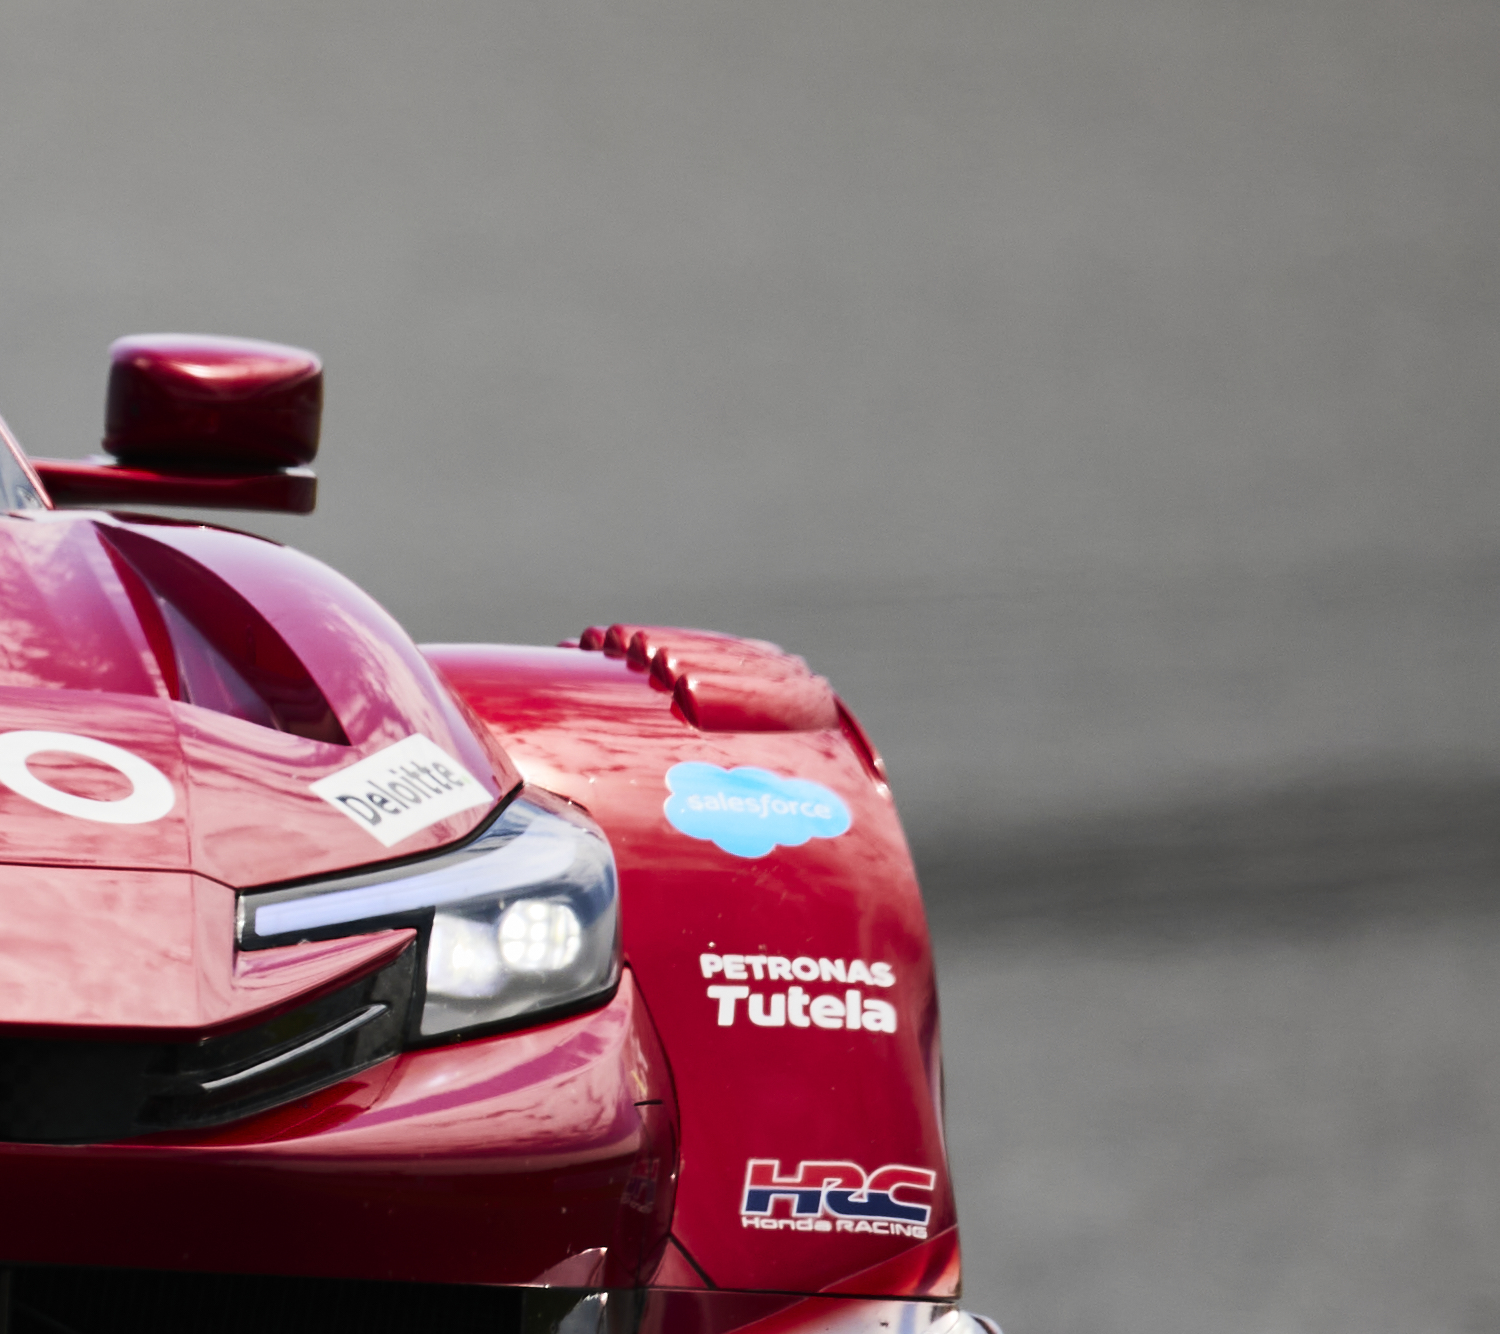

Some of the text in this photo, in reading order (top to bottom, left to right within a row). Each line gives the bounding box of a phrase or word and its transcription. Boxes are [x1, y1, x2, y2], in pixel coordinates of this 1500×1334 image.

[687, 791, 832, 820] salesforce
[700, 953, 896, 988] PETRONAS
[707, 985, 897, 1034] Tutela
[740, 1158, 937, 1226] HRC
[741, 1216, 929, 1240] Honda RACING
